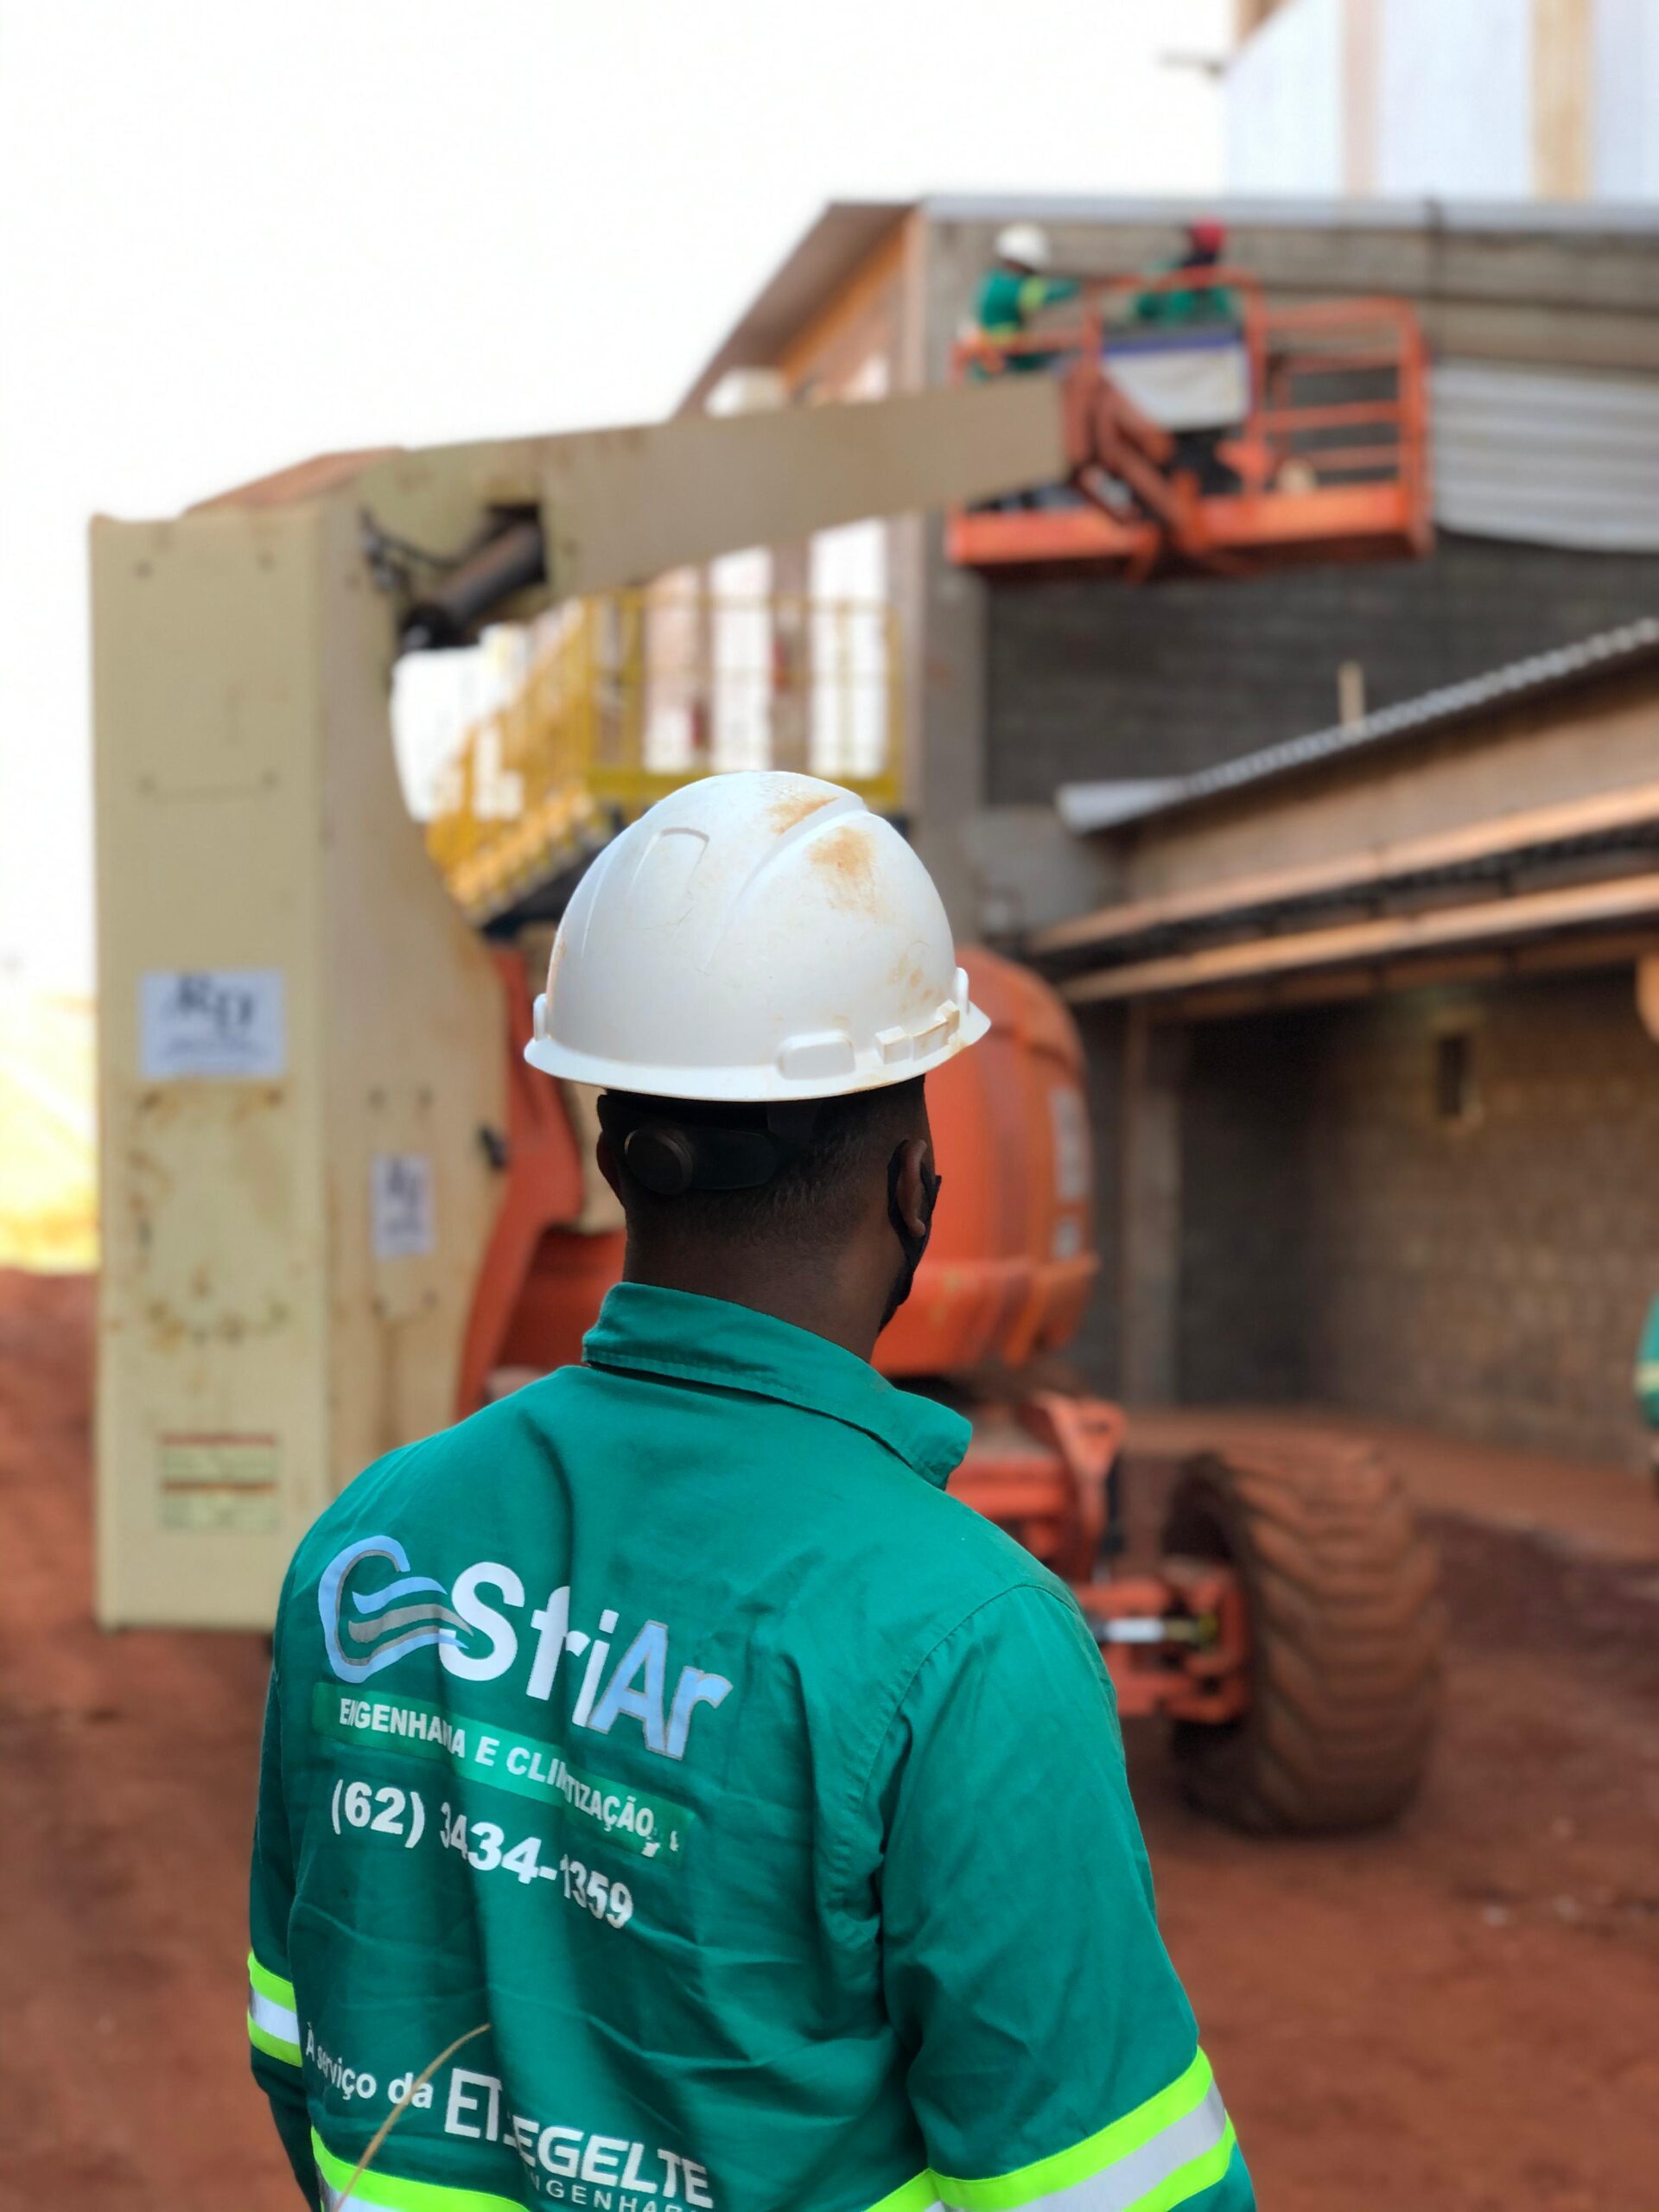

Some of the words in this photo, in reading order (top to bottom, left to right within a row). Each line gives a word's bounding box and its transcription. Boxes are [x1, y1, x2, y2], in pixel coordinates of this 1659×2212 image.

[474, 1735, 500, 1767] E
[505, 1746, 654, 1839] CLIMTIZAÇÃO
[332, 1778, 425, 1849] (62)
[440, 1802, 633, 1929] 3434-1359
[316, 2044, 377, 2101] serviço
[387, 2071, 434, 2109] da
